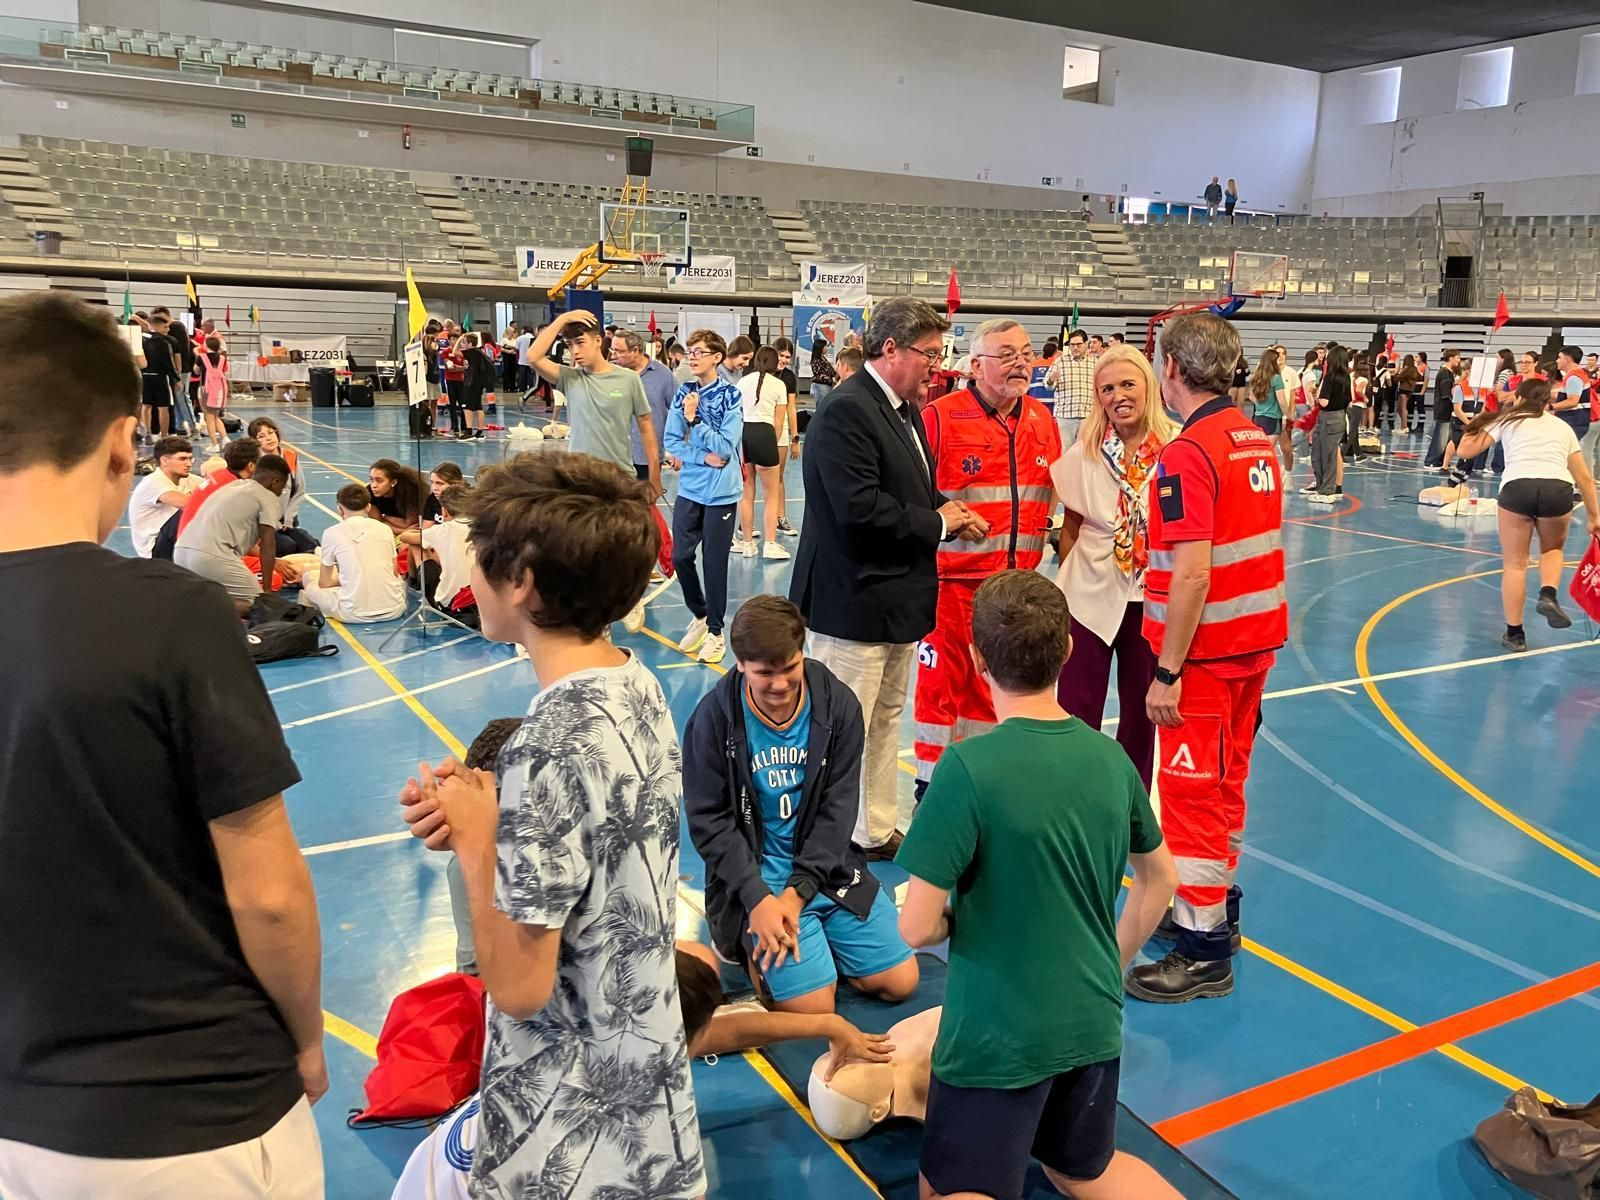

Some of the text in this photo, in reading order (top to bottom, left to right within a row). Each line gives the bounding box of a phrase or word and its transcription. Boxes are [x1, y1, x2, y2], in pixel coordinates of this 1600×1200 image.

[535, 260, 588, 271] JEREZ2
[683, 267, 732, 277] JEREZ2031
[817, 274, 864, 284] JEREZ2031
[300, 350, 343, 361] EZ2031
[412, 360, 419, 383] 7
[917, 641, 938, 669] 61
[752, 746, 808, 773] KLAHOM
[768, 768, 797, 788] CITY
[780, 793, 792, 819] 0
